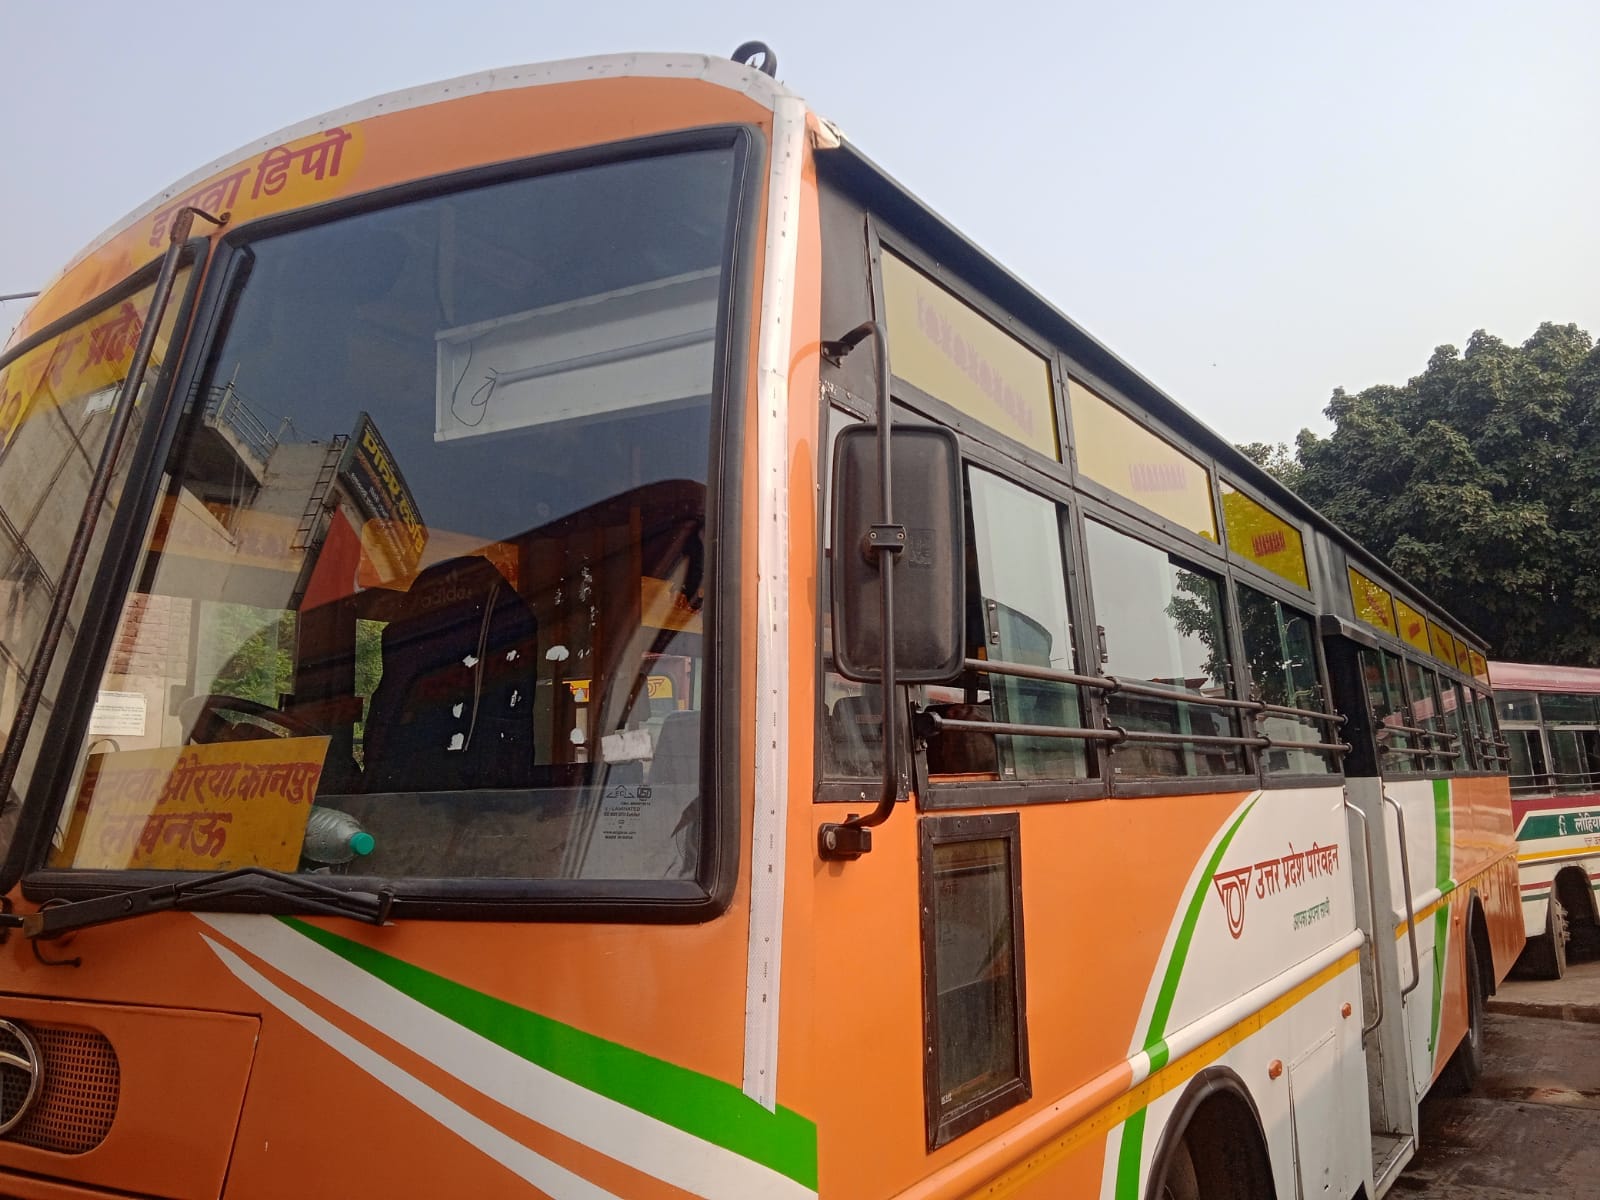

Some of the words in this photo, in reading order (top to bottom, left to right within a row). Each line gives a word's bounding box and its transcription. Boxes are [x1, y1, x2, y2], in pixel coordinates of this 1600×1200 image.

[251, 127, 353, 200] डिपो
[1254, 859, 1281, 900] उत्तर
[1281, 842, 1305, 889] प्रदेश
[1305, 841, 1340, 880] परिवहन
